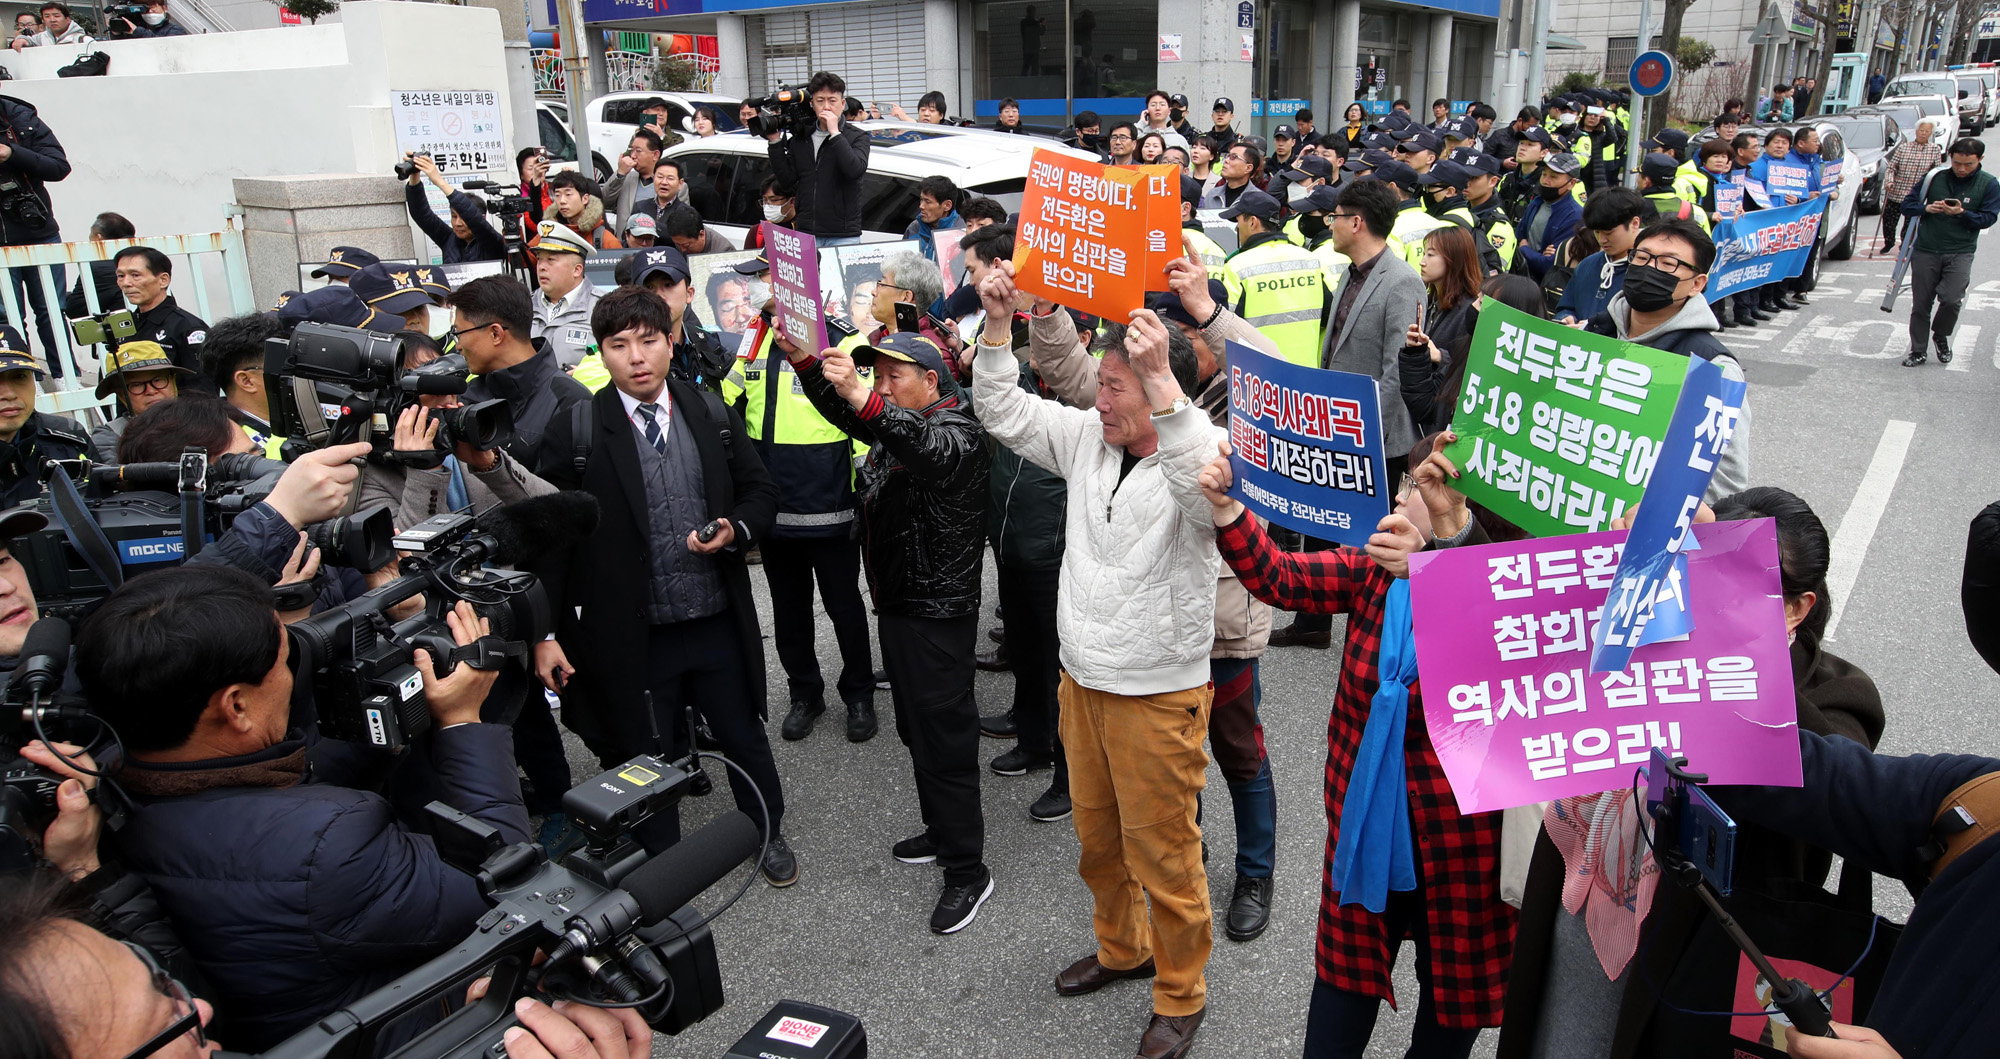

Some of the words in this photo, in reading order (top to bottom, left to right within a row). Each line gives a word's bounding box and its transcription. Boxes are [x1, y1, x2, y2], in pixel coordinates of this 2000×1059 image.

[1241, 14, 1250, 26] 25
[400, 93, 441, 107] 청소년은
[443, 92, 473, 106] 내일의
[475, 92, 494, 106] 희망
[420, 143, 451, 152] 광주광역시
[453, 142, 471, 151] 청소년
[1031, 160, 1065, 193] 국민의
[1067, 170, 1137, 211] 명령이다.
[1041, 195, 1106, 238] 전두환은
[772, 229, 802, 260] 전두환은
[1022, 221, 1066, 259] 역사의
[1072, 237, 1127, 277] 심판을
[776, 256, 805, 289] 참회하고
[1042, 259, 1095, 299] 받으라
[1256, 275, 1316, 293] POLICE
[773, 281, 793, 310] 역사의
[792, 291, 818, 322] 심판을
[784, 312, 809, 344] 받으라!
[1493, 321, 1653, 415] 전두환은
[1231, 365, 1365, 448] 5.18역사왜곡
[1231, 413, 1269, 472] 특별법
[1270, 434, 1375, 496] 제정하라!
[1241, 477, 1289, 515] 더불어민주당
[1290, 500, 1351, 529] 전라남도당
[1465, 436, 1626, 534] 사죄하라!
[129, 543, 166, 557] MBC
[167, 542, 184, 554] NE
[1447, 669, 1587, 727] 역사의
[1600, 656, 1759, 709] 심판을
[373, 725, 383, 743] YTN
[1521, 721, 1683, 781] 받으라!
[600, 782, 626, 795] SONY
[778, 1019, 822, 1039] 일요신문
